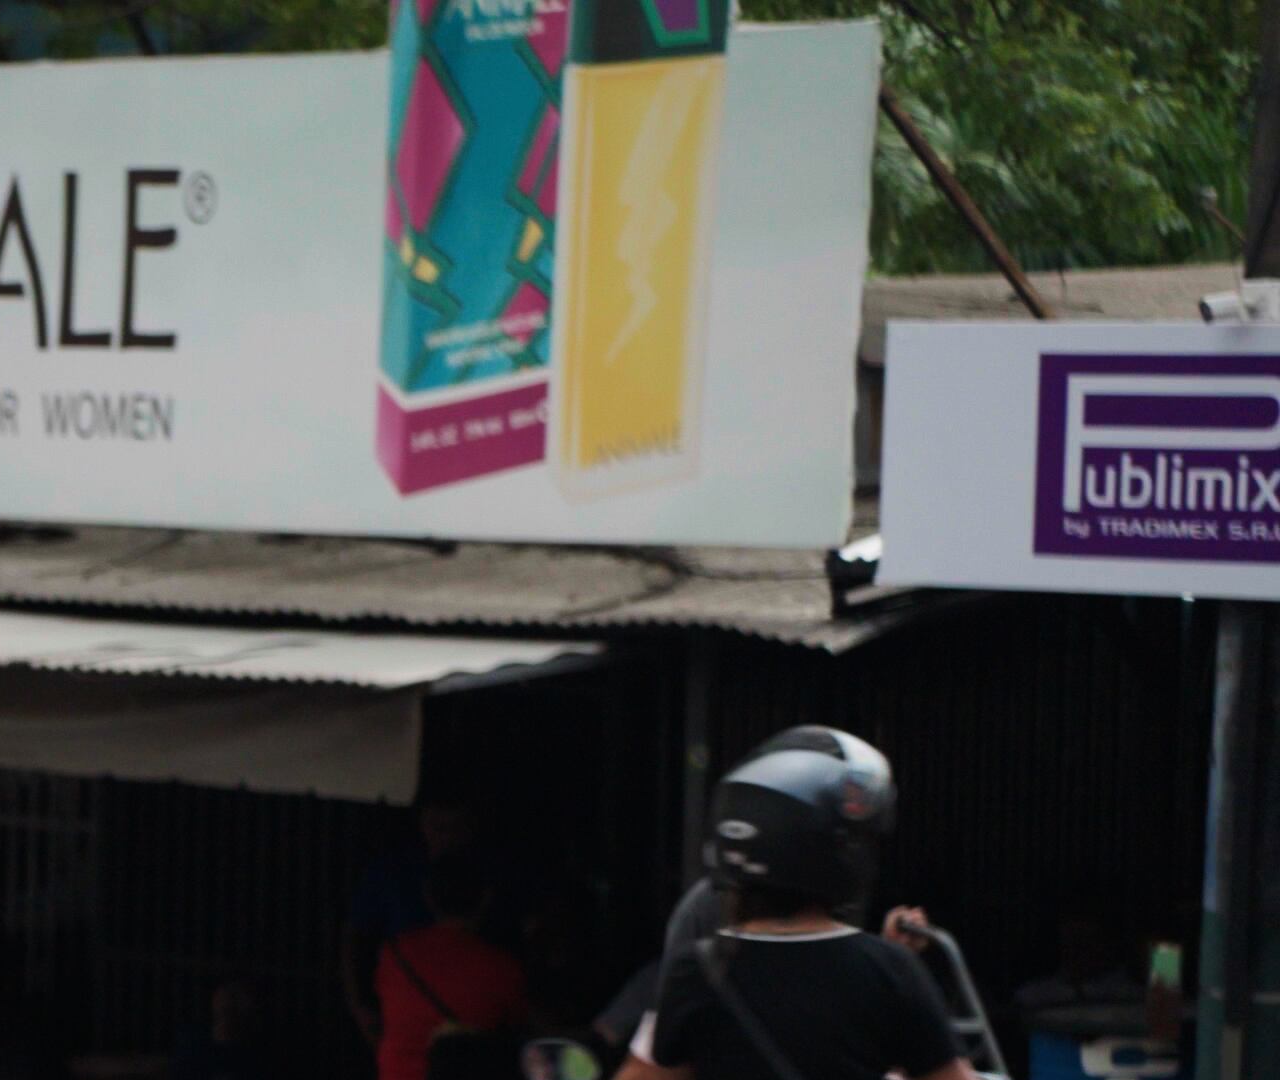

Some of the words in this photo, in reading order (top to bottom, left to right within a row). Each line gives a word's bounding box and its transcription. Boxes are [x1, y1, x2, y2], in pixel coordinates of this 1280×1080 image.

[42, 392, 173, 440] WOMEN
[1062, 372, 1280, 513] Publimix
[1063, 516, 1090, 539] by
[1099, 517, 1219, 540] TRADIMEX
